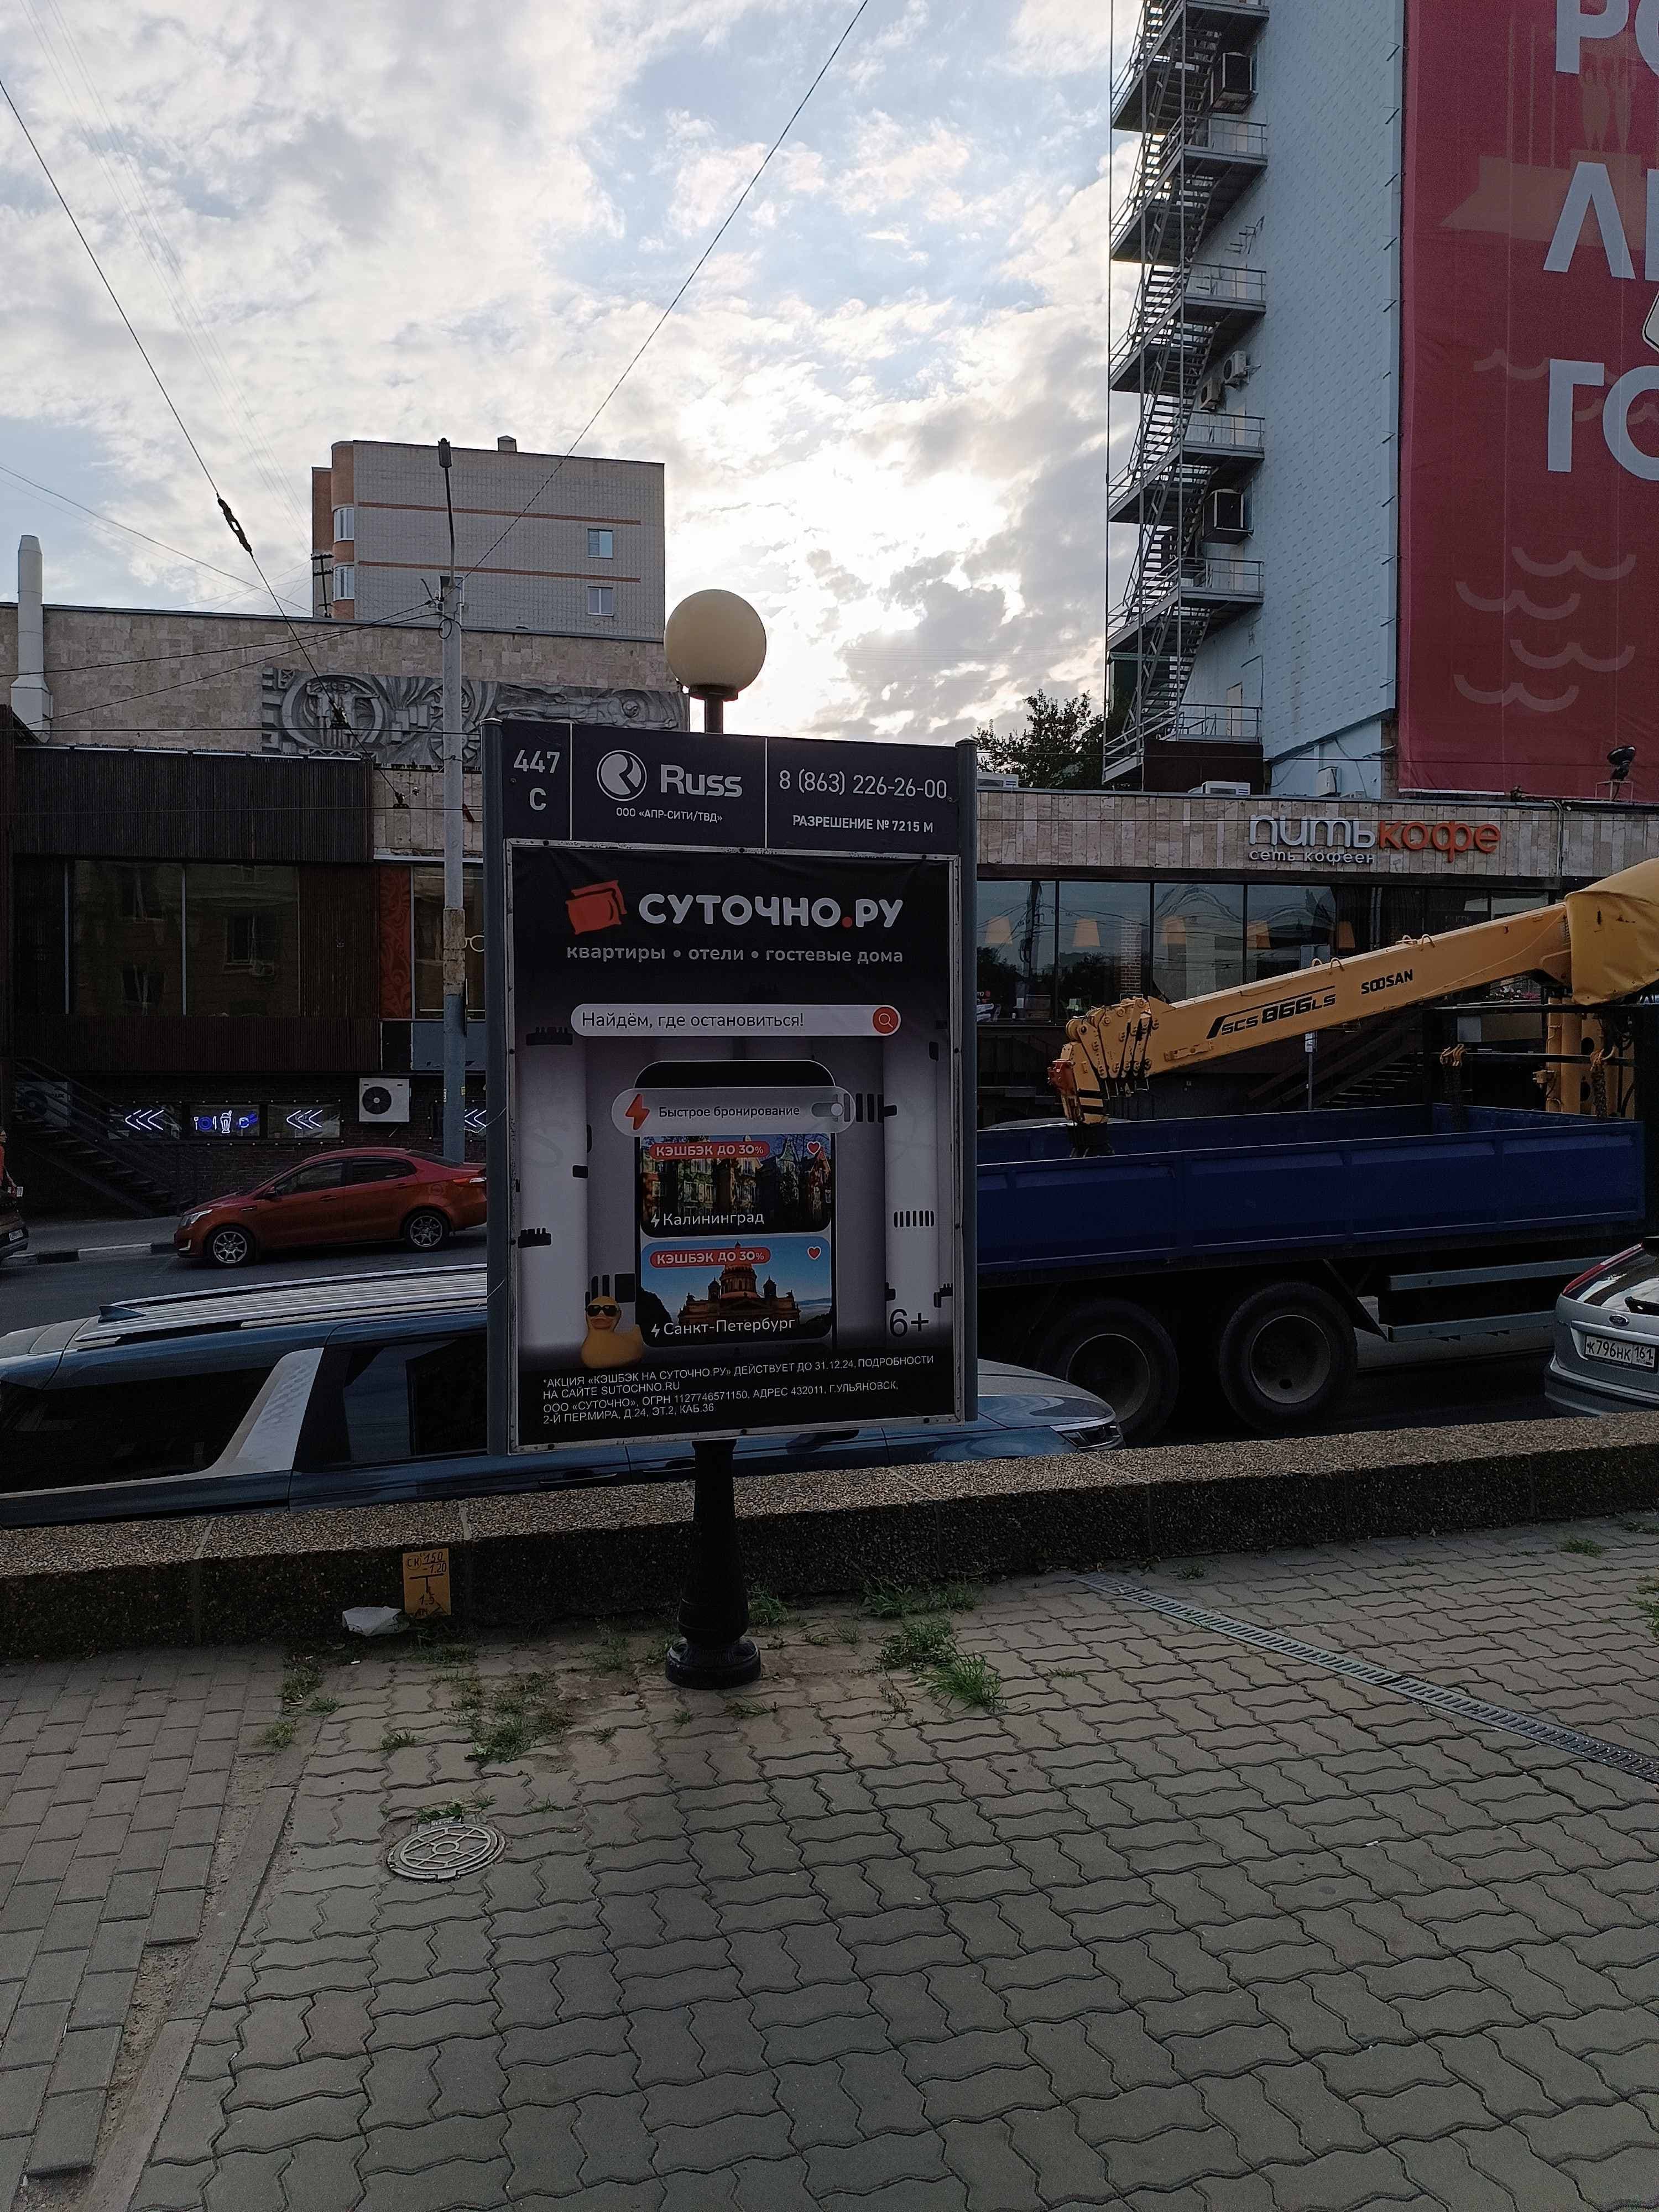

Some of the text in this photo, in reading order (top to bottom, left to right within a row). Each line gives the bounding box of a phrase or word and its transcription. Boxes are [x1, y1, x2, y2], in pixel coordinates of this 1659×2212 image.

[514, 749, 560, 774] 447
[660, 764, 743, 797] Russ
[779, 769, 947, 799] 8 (863) 226-26-00
[529, 787, 546, 811] С
[616, 807, 722, 823] ООО «АПР-СИТИ/ТВД»
[792, 815, 933, 833] РАЗРЕШЕНИЕ № 7215 М
[1249, 849, 1375, 865] сеть кофеен
[639, 893, 903, 928] СУТОЧНО.РУ
[567, 947, 903, 964] квартиры отели гостевые дома
[1361, 969, 1413, 995] SOOSAN
[582, 1012, 804, 1029] Найдём, где остановиться!
[659, 1105, 800, 1120] Быстрое бронирование
[656, 1144, 764, 1156] КЭШБЭК ДО 30%
[663, 1213, 764, 1226] Калининград
[657, 1251, 764, 1265] КЭШБЭК ДО 30%
[663, 1319, 795, 1335] Санкт-Петербург
[889, 1308, 929, 1337] 6+
[588, 1373, 639, 1384] «КЭШБЭК
[642, 1371, 656, 1381] НА
[659, 1367, 731, 1380] СУТОЧНО.РУ»
[734, 1362, 795, 1376] ДЕЙСТВУЕТ
[797, 1362, 812, 1373] ДО
[858, 1355, 933, 1368] ПОДРОБНОСТИ
[543, 1402, 569, 1413] ООО
[642, 1396, 670, 1406] ОГРН
[753, 1387, 788, 1399] АДРЕС
[791, 1386, 827, 1396] 432011,
[830, 1380, 899, 1394] Г.УЛЬЯНОВСК,
[544, 1381, 680, 1400] НА САЙТЕ SUTOCHNO.RU
[544, 1413, 561, 1425] 2-Й
[624, 1408, 649, 1420] Д.24,
[652, 1406, 676, 1416] ЭТ.2,
[679, 1403, 714, 1415] КАБ.36
